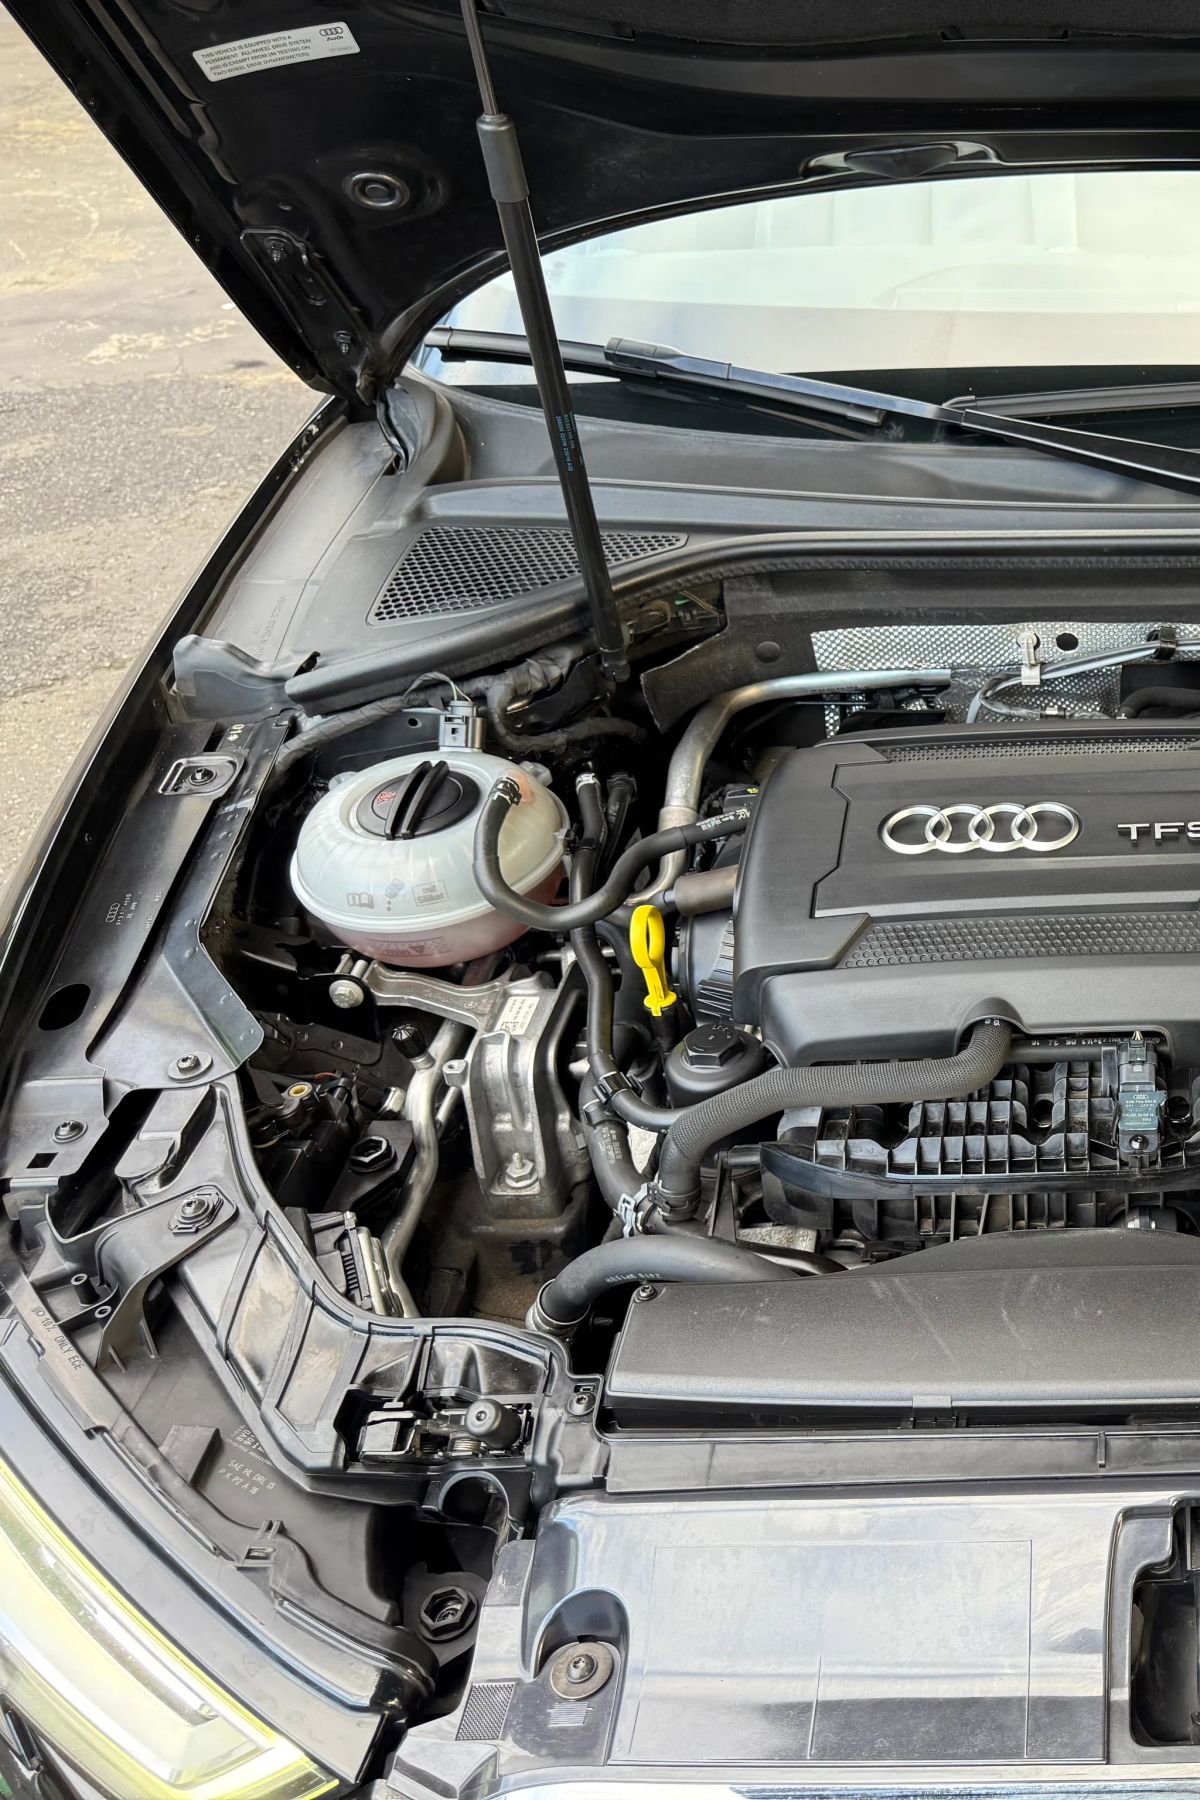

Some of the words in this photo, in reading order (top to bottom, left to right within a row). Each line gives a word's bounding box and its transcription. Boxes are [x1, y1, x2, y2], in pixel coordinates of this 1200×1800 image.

[54, 1335, 73, 1354] ONLY
[68, 1356, 85, 1370] ECE
[228, 1460, 244, 1471] SAE
[253, 1474, 267, 1485] DRL
